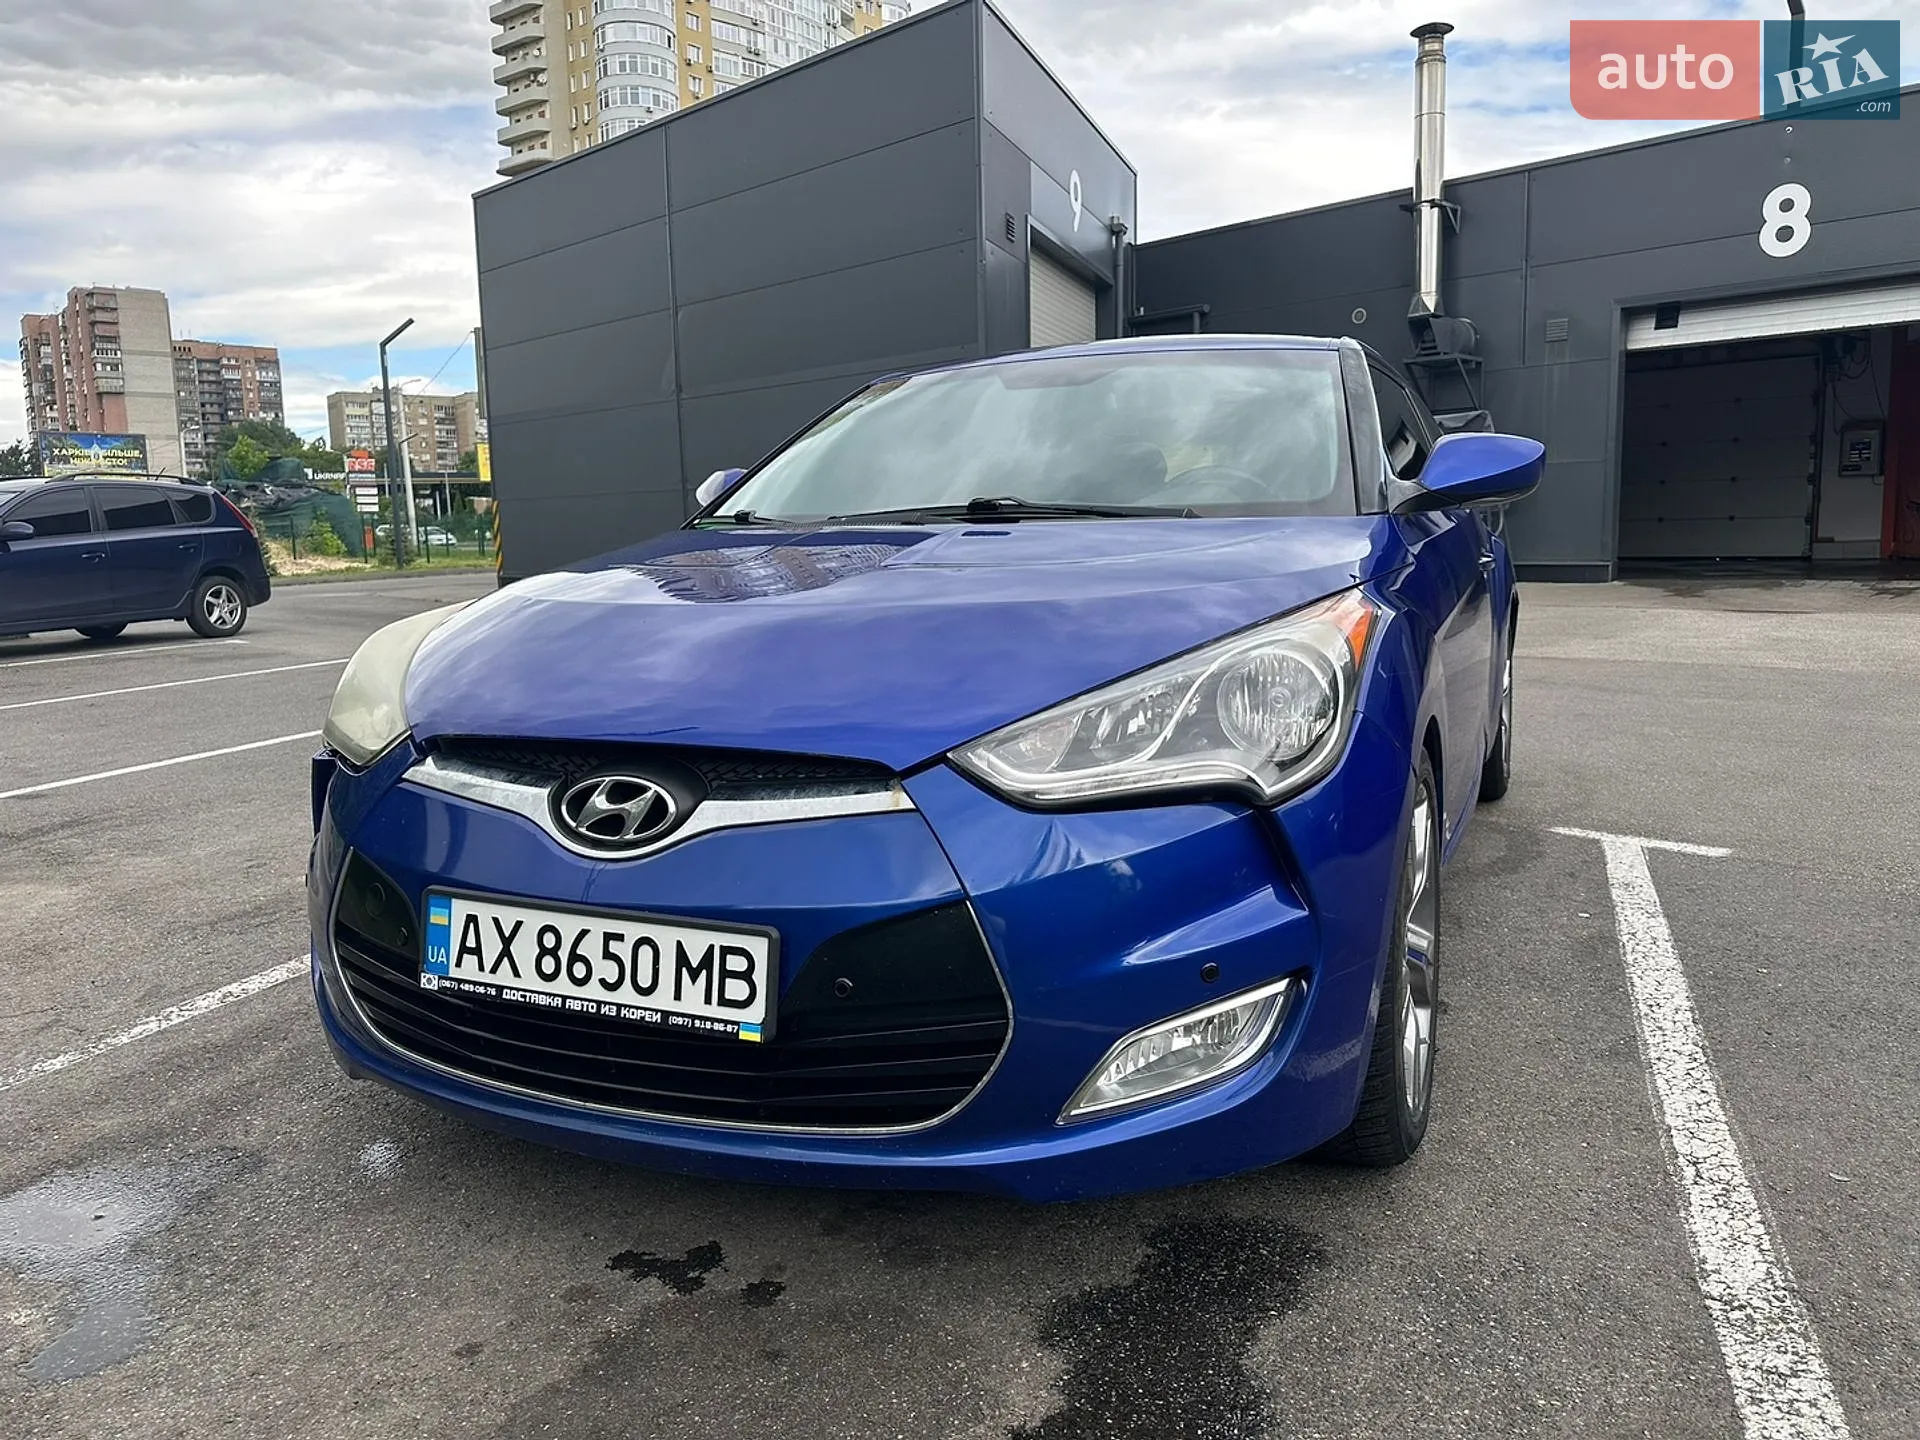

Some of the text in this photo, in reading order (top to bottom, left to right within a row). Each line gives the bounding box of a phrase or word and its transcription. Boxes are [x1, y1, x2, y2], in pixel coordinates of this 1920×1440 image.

[1069, 168, 1082, 233] 9
[1759, 182, 1812, 258] 8
[427, 944, 448, 966] UA
[454, 913, 758, 1010] AX 8650 MB
[502, 988, 563, 1008] ДОСТАВКА
[565, 998, 598, 1013] АВТО
[601, 1004, 617, 1016] ИЗ
[620, 1006, 662, 1023] КОРЕИ
